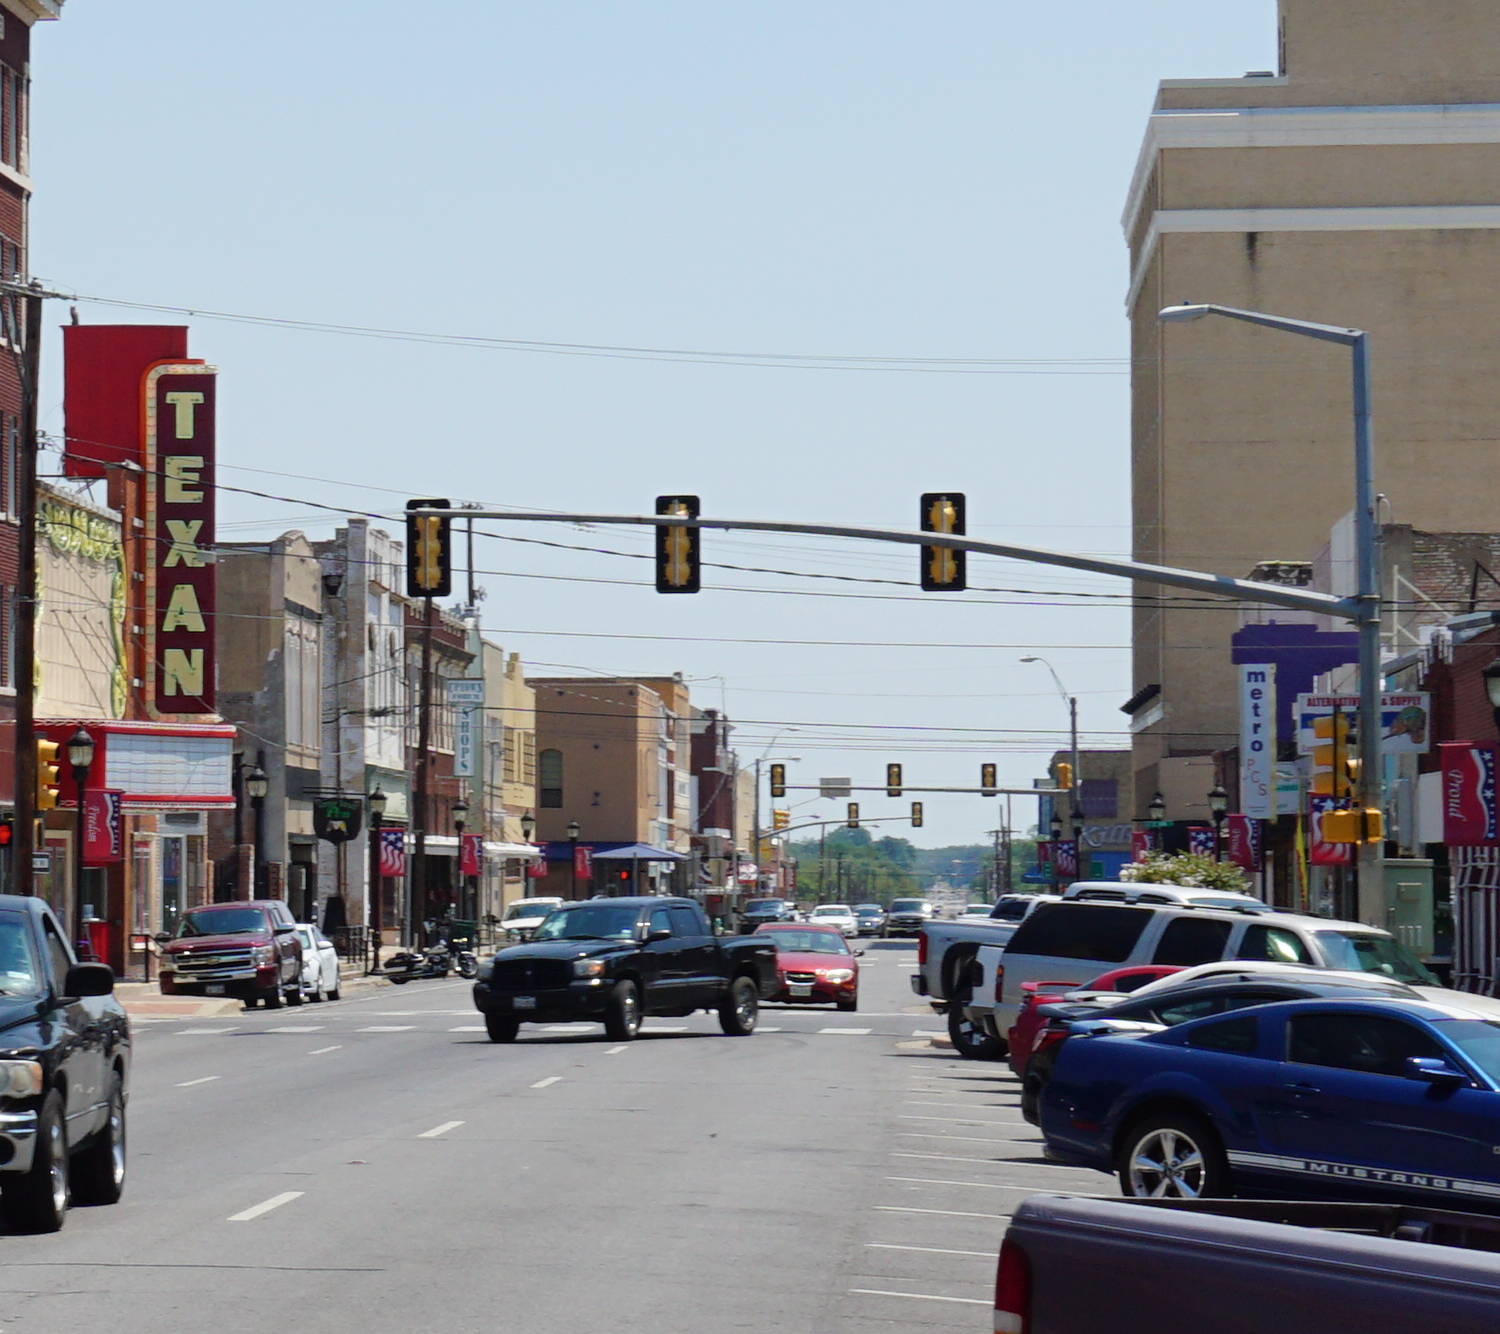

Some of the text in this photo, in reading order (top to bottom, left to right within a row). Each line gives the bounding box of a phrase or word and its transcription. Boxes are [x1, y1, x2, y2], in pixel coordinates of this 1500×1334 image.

[162, 391, 206, 697] TEXAN
[460, 708, 470, 773] SHOPS
[1246, 670, 1267, 753] metro
[87, 805, 101, 843] Freedom
[1447, 769, 1467, 822] Proud
[1309, 1161, 1449, 1190] MUSTANG
